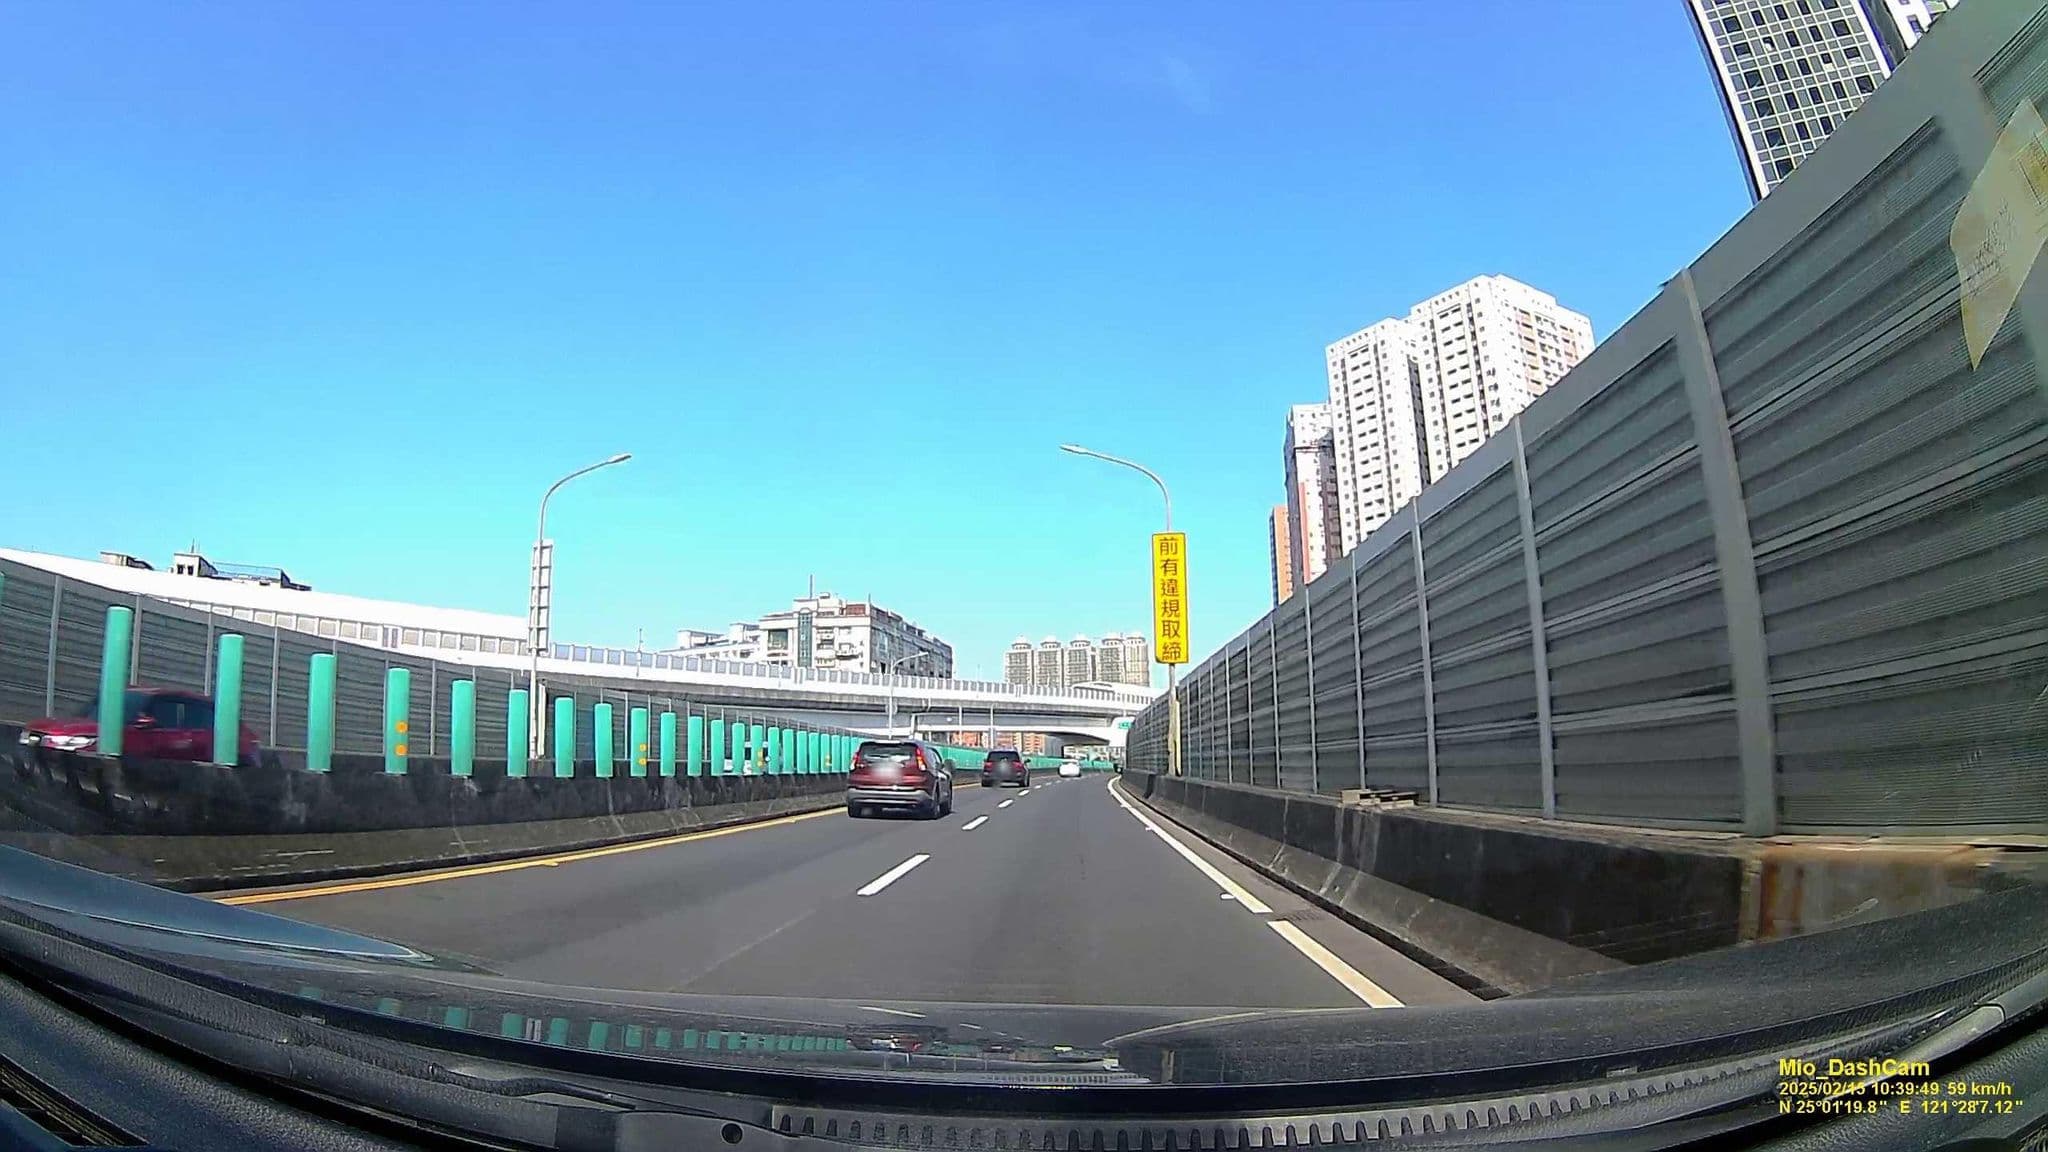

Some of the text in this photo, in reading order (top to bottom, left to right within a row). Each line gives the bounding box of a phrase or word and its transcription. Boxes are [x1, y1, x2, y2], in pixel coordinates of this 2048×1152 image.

[1159, 537, 1181, 660] 前有違規取締
